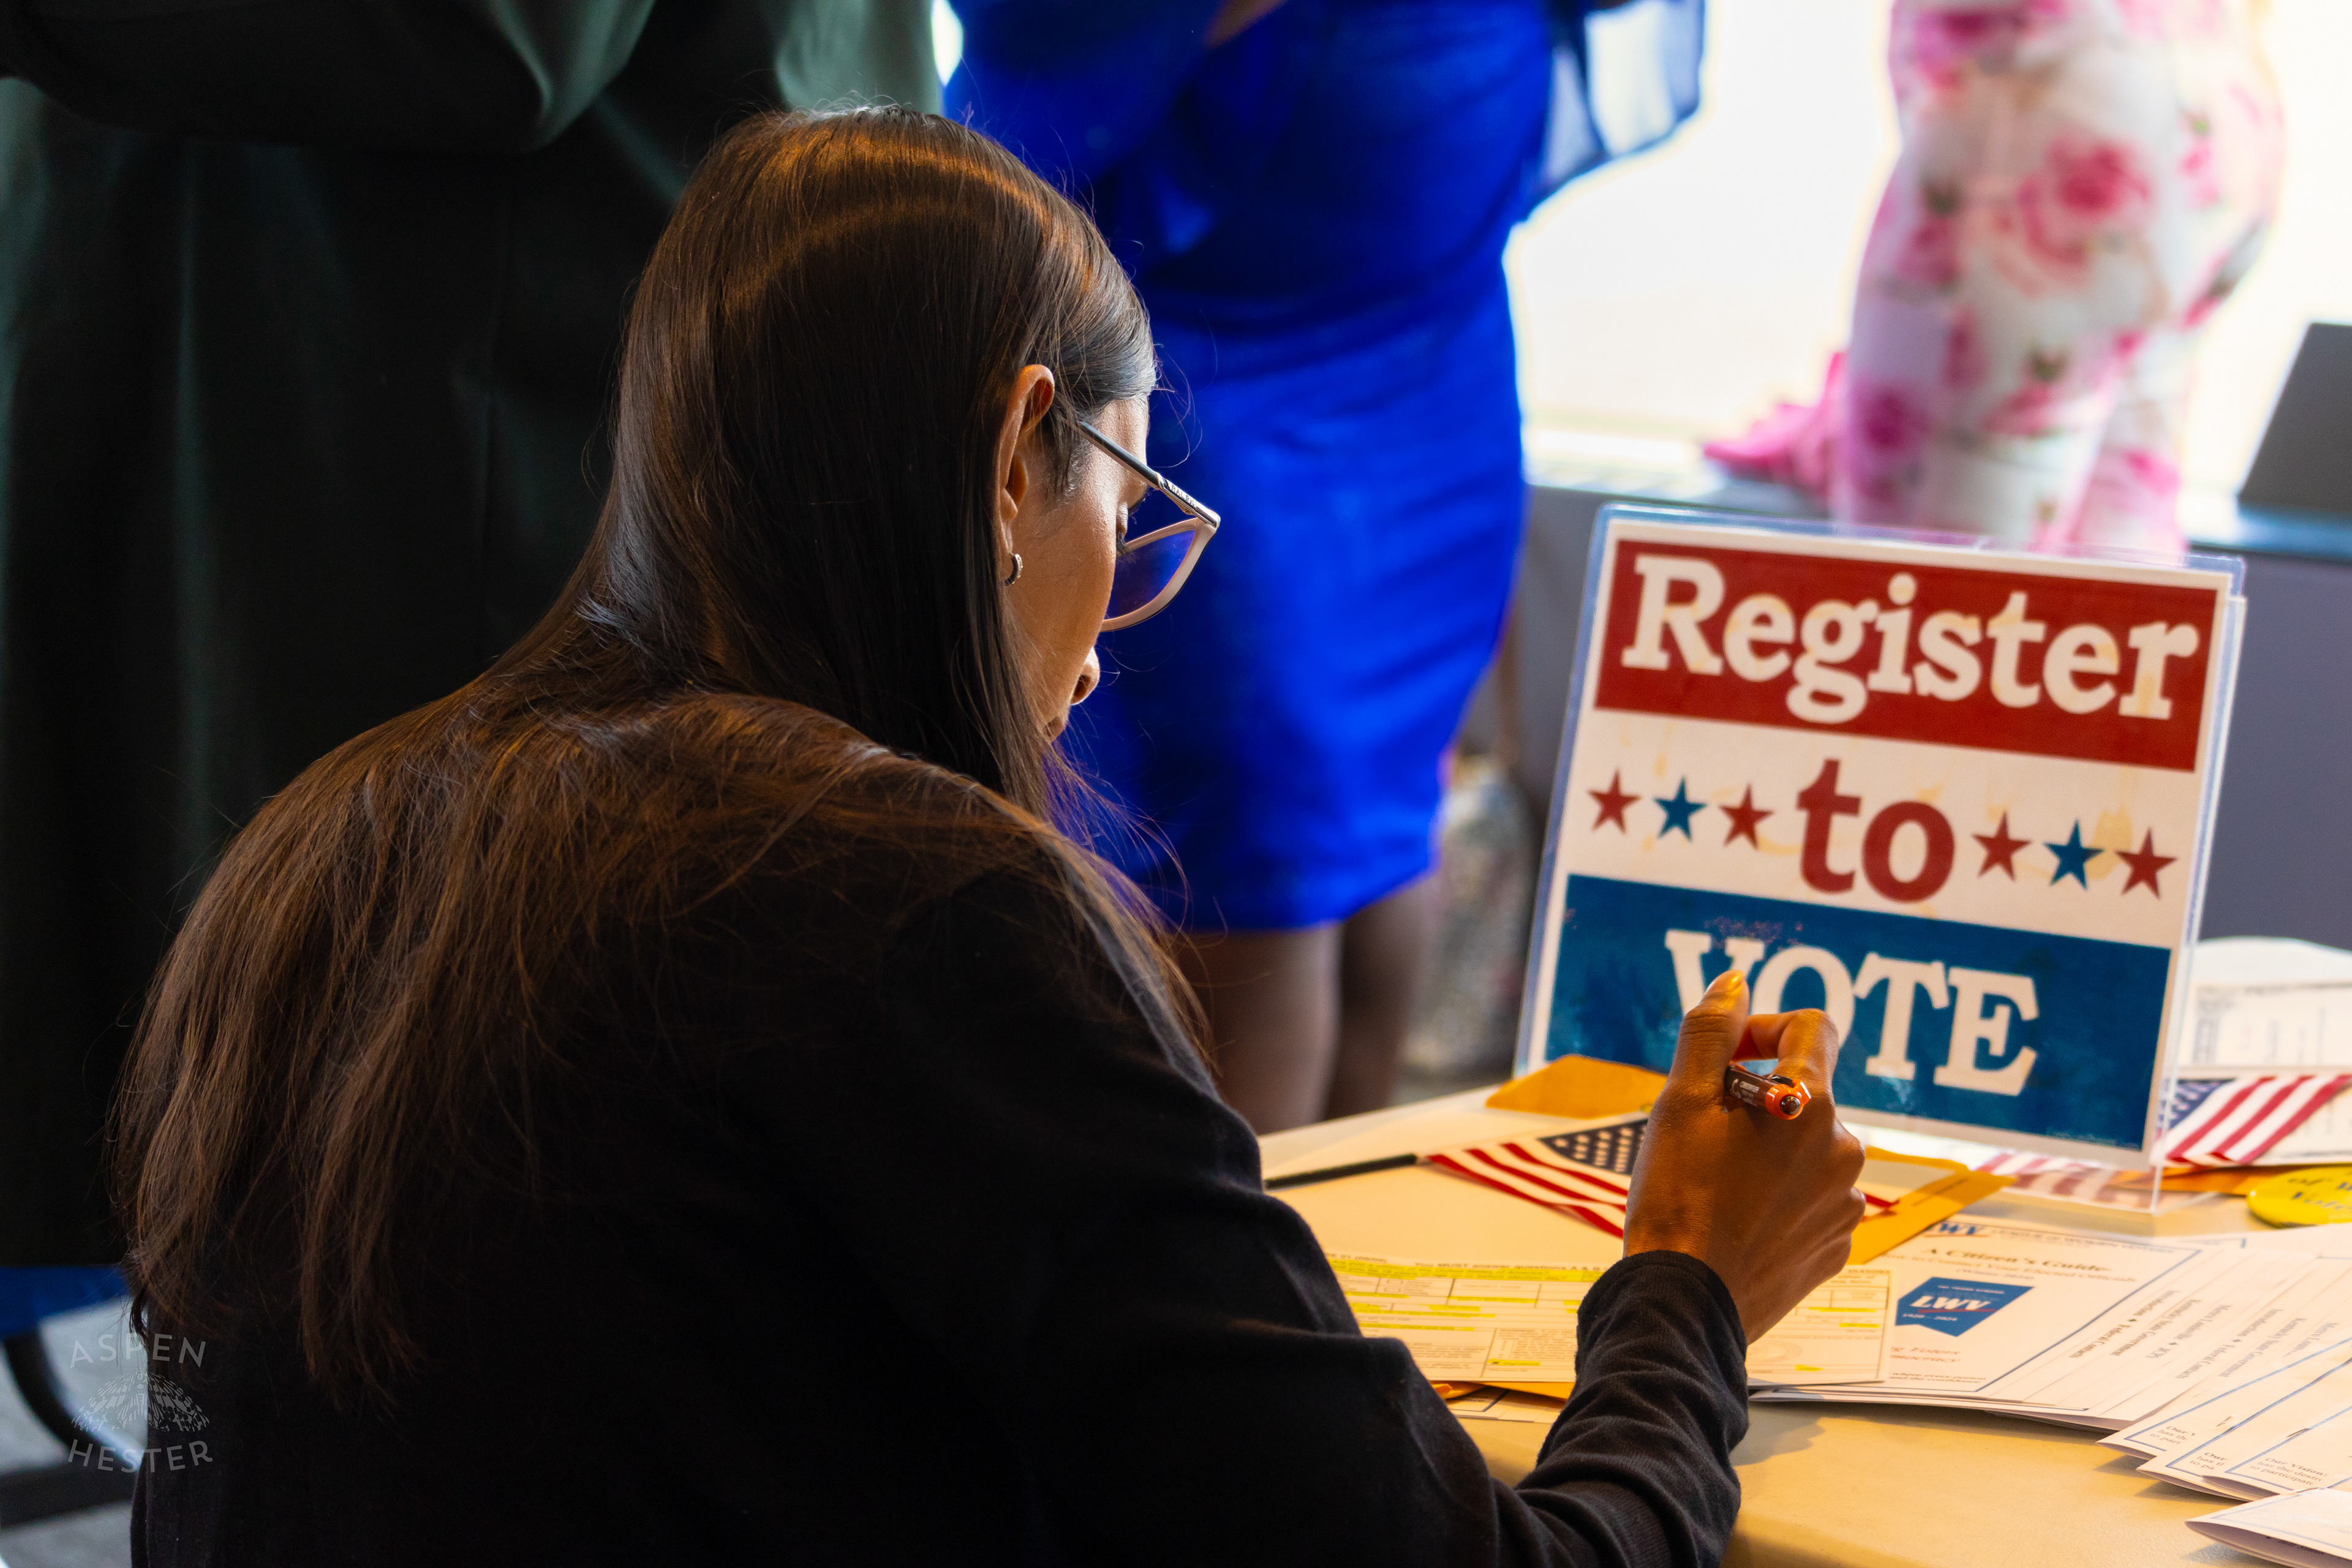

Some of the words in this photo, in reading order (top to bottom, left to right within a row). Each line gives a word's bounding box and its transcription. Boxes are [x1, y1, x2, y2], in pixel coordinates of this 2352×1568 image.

[1621, 554, 2199, 725] Register
[1796, 757, 1956, 904] to
[2041, 1260, 2112, 1272] Guide
[1909, 1295, 1991, 1311] LWV
[2158, 1429, 2177, 1438] has
[2166, 1425, 2188, 1435] Our
[2196, 1455, 2215, 1464] has
[2204, 1452, 2228, 1461] Our
[2256, 1461, 2275, 1470] has
[2264, 1457, 2288, 1466] Our
[2290, 1463, 2328, 1477] Vision:
